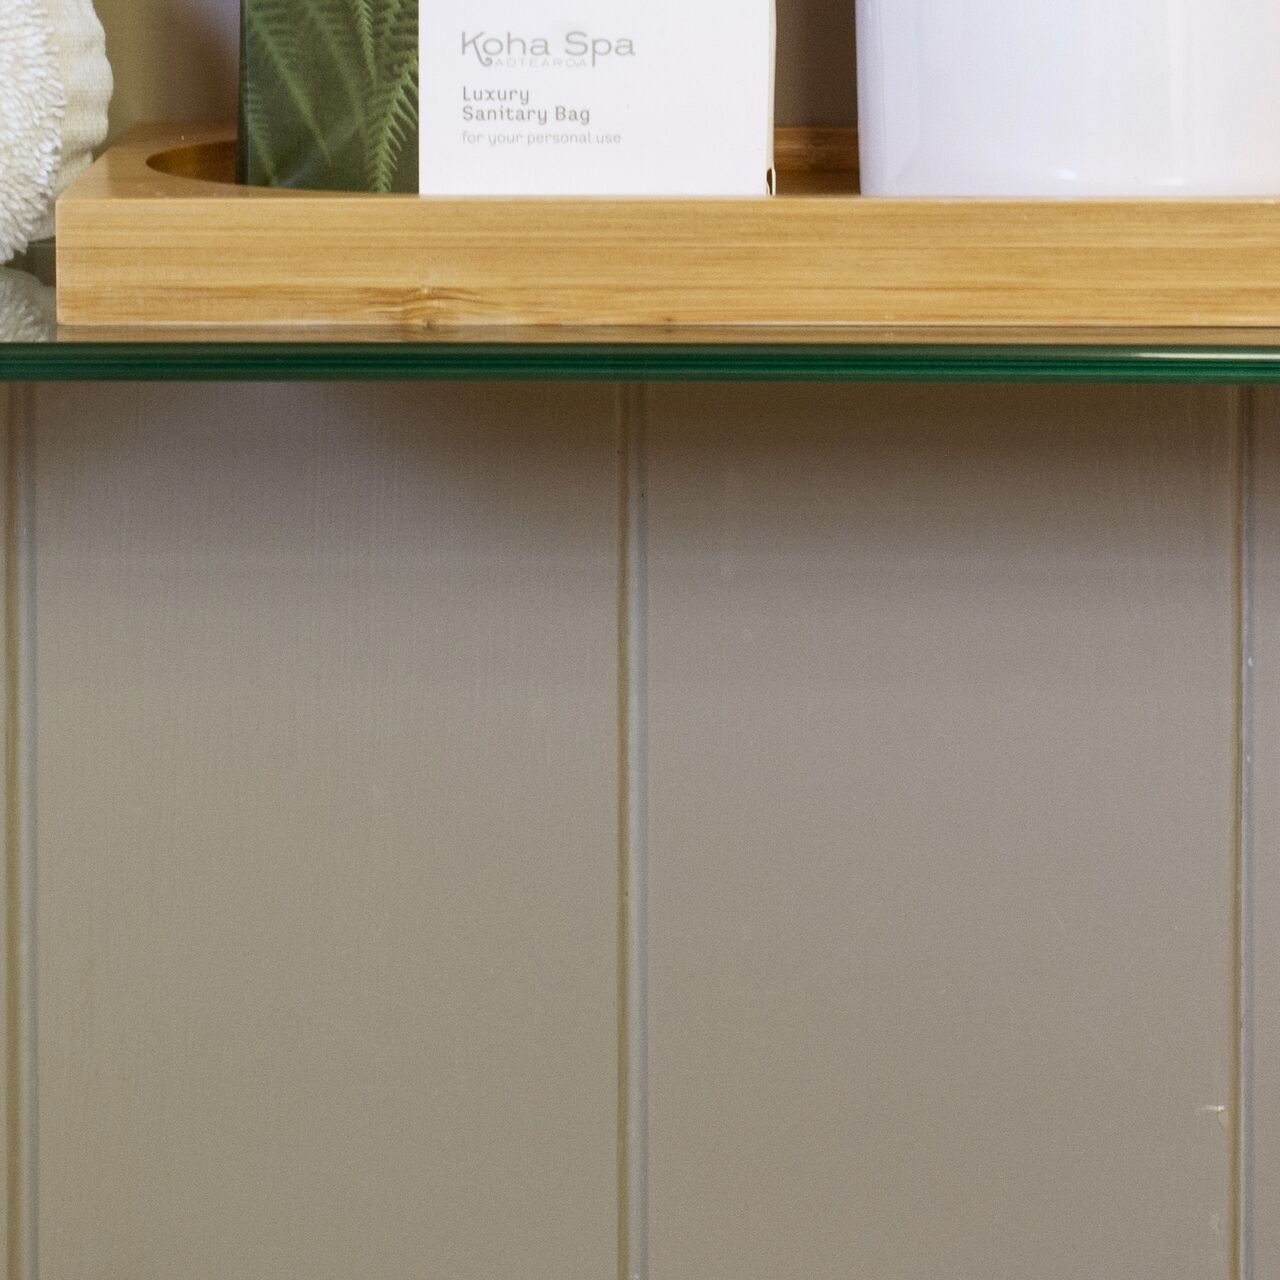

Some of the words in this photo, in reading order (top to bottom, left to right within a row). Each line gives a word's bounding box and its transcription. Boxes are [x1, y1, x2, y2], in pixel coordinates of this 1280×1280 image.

[461, 31, 549, 67] Koha
[565, 31, 636, 67] Spa
[462, 86, 530, 105] Luxury
[462, 105, 547, 124] Sanitary
[554, 106, 591, 124] Bag
[462, 131, 484, 143] for
[488, 134, 523, 147] your
[527, 130, 592, 147] personal
[596, 134, 622, 144] use
